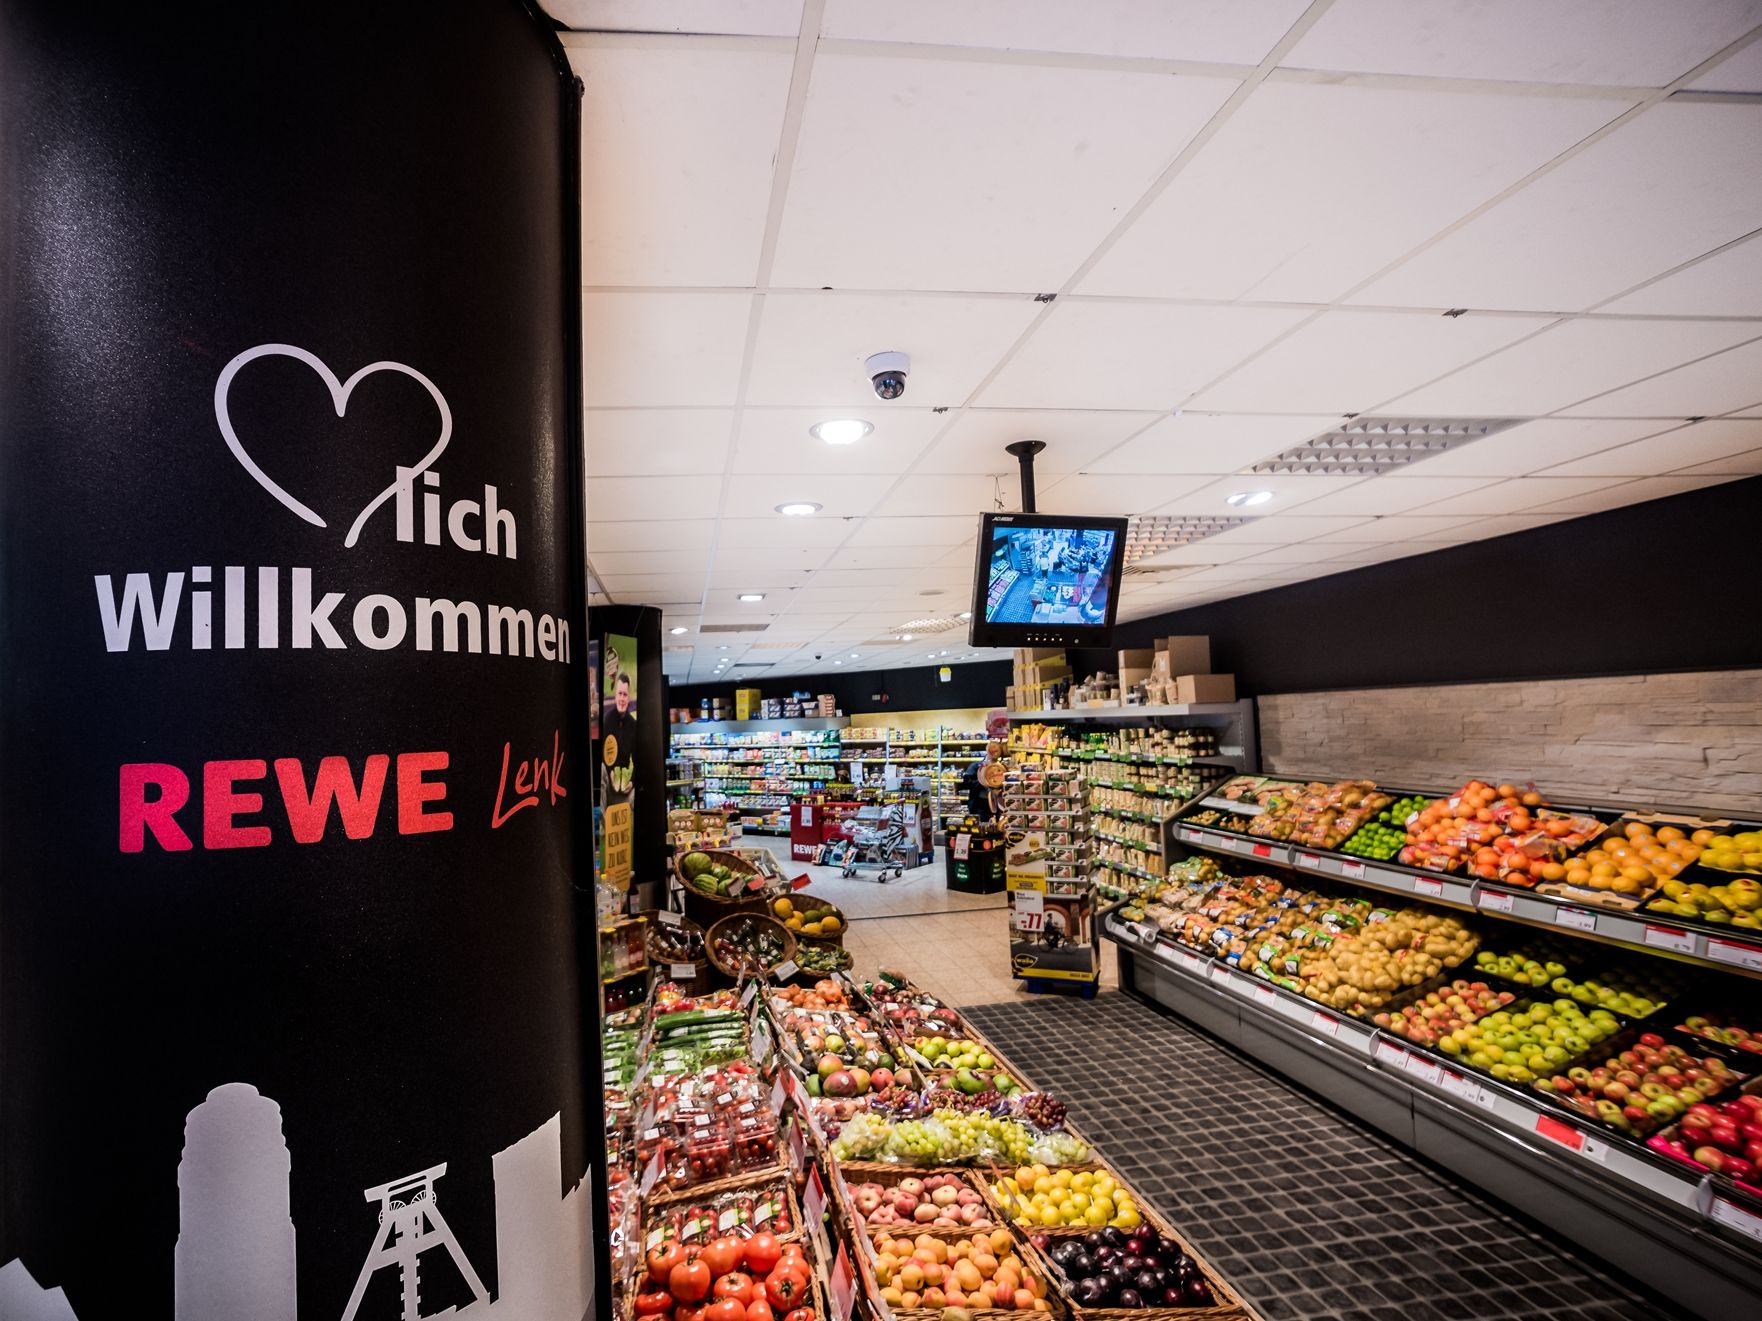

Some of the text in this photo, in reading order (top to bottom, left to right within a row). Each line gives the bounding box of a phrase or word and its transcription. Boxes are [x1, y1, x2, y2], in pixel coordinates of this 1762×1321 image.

[396, 465, 517, 559] lich
[94, 566, 571, 664] Willkommen
[119, 729, 567, 853] REWE Lenk
[608, 831, 620, 848] KEIN
